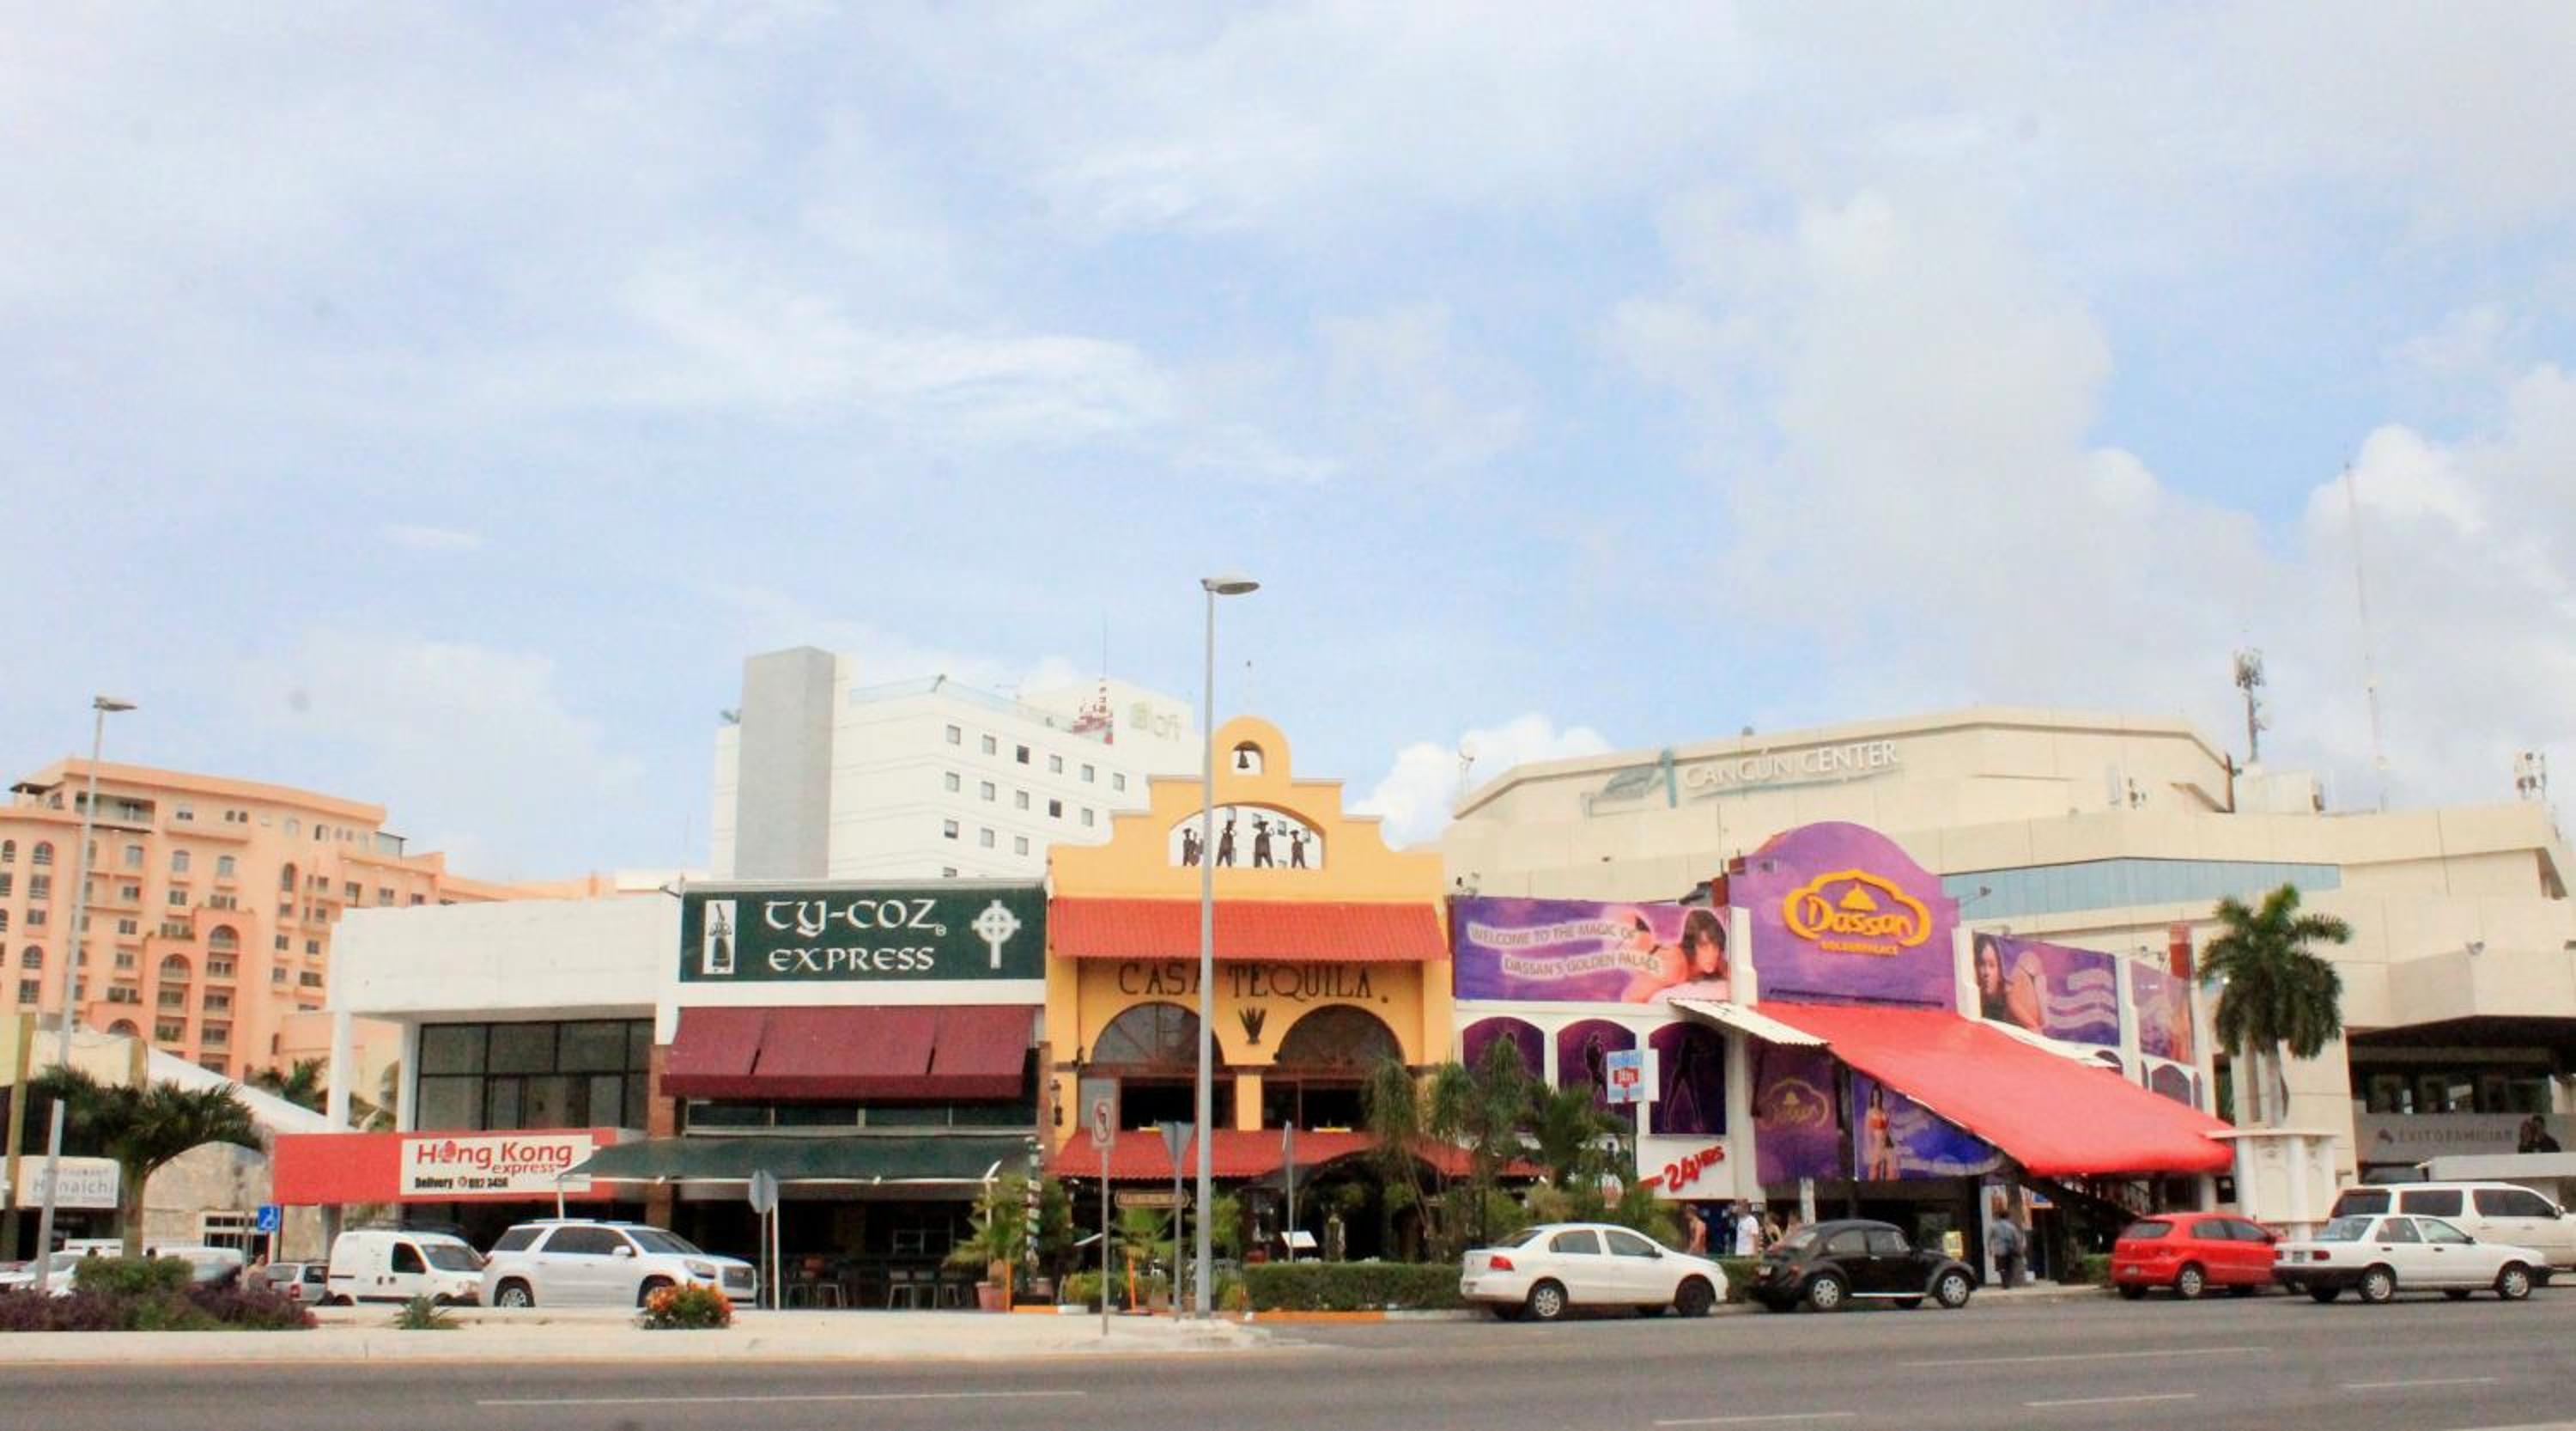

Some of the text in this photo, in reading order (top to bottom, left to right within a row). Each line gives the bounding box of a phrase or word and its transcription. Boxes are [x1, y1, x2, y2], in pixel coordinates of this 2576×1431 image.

[1803, 740, 1899, 773] CENTER
[1807, 892, 1913, 937] Dassan
[1470, 927, 1531, 945] WELCOME
[1534, 929, 1550, 942] TO
[1552, 925, 1576, 939] THE
[1578, 923, 1617, 937] MAGIC
[769, 947, 935, 973] EXPRESS
[1504, 952, 1660, 976] DASSAN'S GOLDEN PALACE
[1227, 963, 1373, 1002] TEQUILA
[416, 1140, 574, 1169] Hong Kong
[492, 1162, 556, 1176] express
[32, 1178, 114, 1195] Hnaichi
